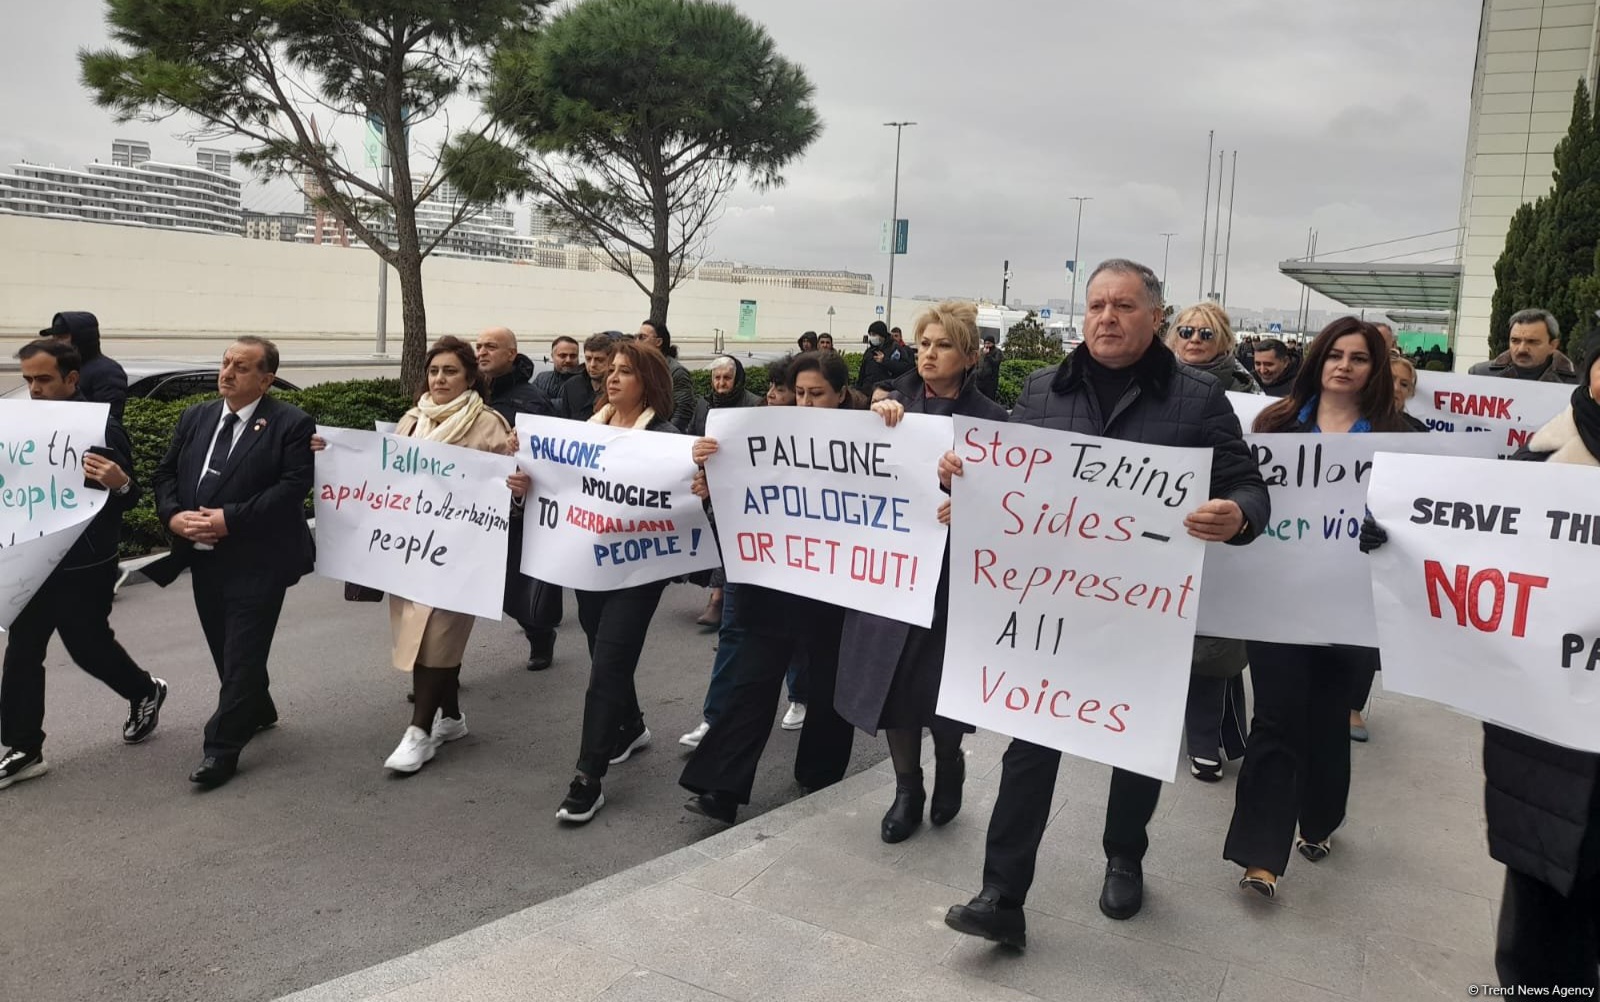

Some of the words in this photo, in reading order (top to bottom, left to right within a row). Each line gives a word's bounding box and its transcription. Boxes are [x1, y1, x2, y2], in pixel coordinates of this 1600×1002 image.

[1434, 390, 1521, 422] FRANK,
[0, 439, 35, 465] ve
[48, 430, 77, 471] th
[530, 434, 607, 472] PALLONE,
[747, 435, 898, 480] PALLONE,
[965, 427, 1053, 483] Stop
[1070, 443, 1195, 507] Taking
[321, 480, 412, 511] apologize
[415, 489, 432, 515] to
[582, 476, 672, 509] APOLOGIZE
[539, 497, 559, 529] TO
[566, 505, 675, 534] AZERBAIJANI
[1323, 508, 1360, 540] vio
[1410, 498, 1521, 535] SERVE
[369, 528, 448, 567] people
[737, 532, 776, 564] OR
[785, 535, 841, 575] GET
[850, 545, 918, 591] OUT!
[974, 549, 1194, 619] Represent
[1424, 559, 1549, 638] NOT
[995, 610, 1065, 655] All
[982, 666, 1131, 733] Voices
